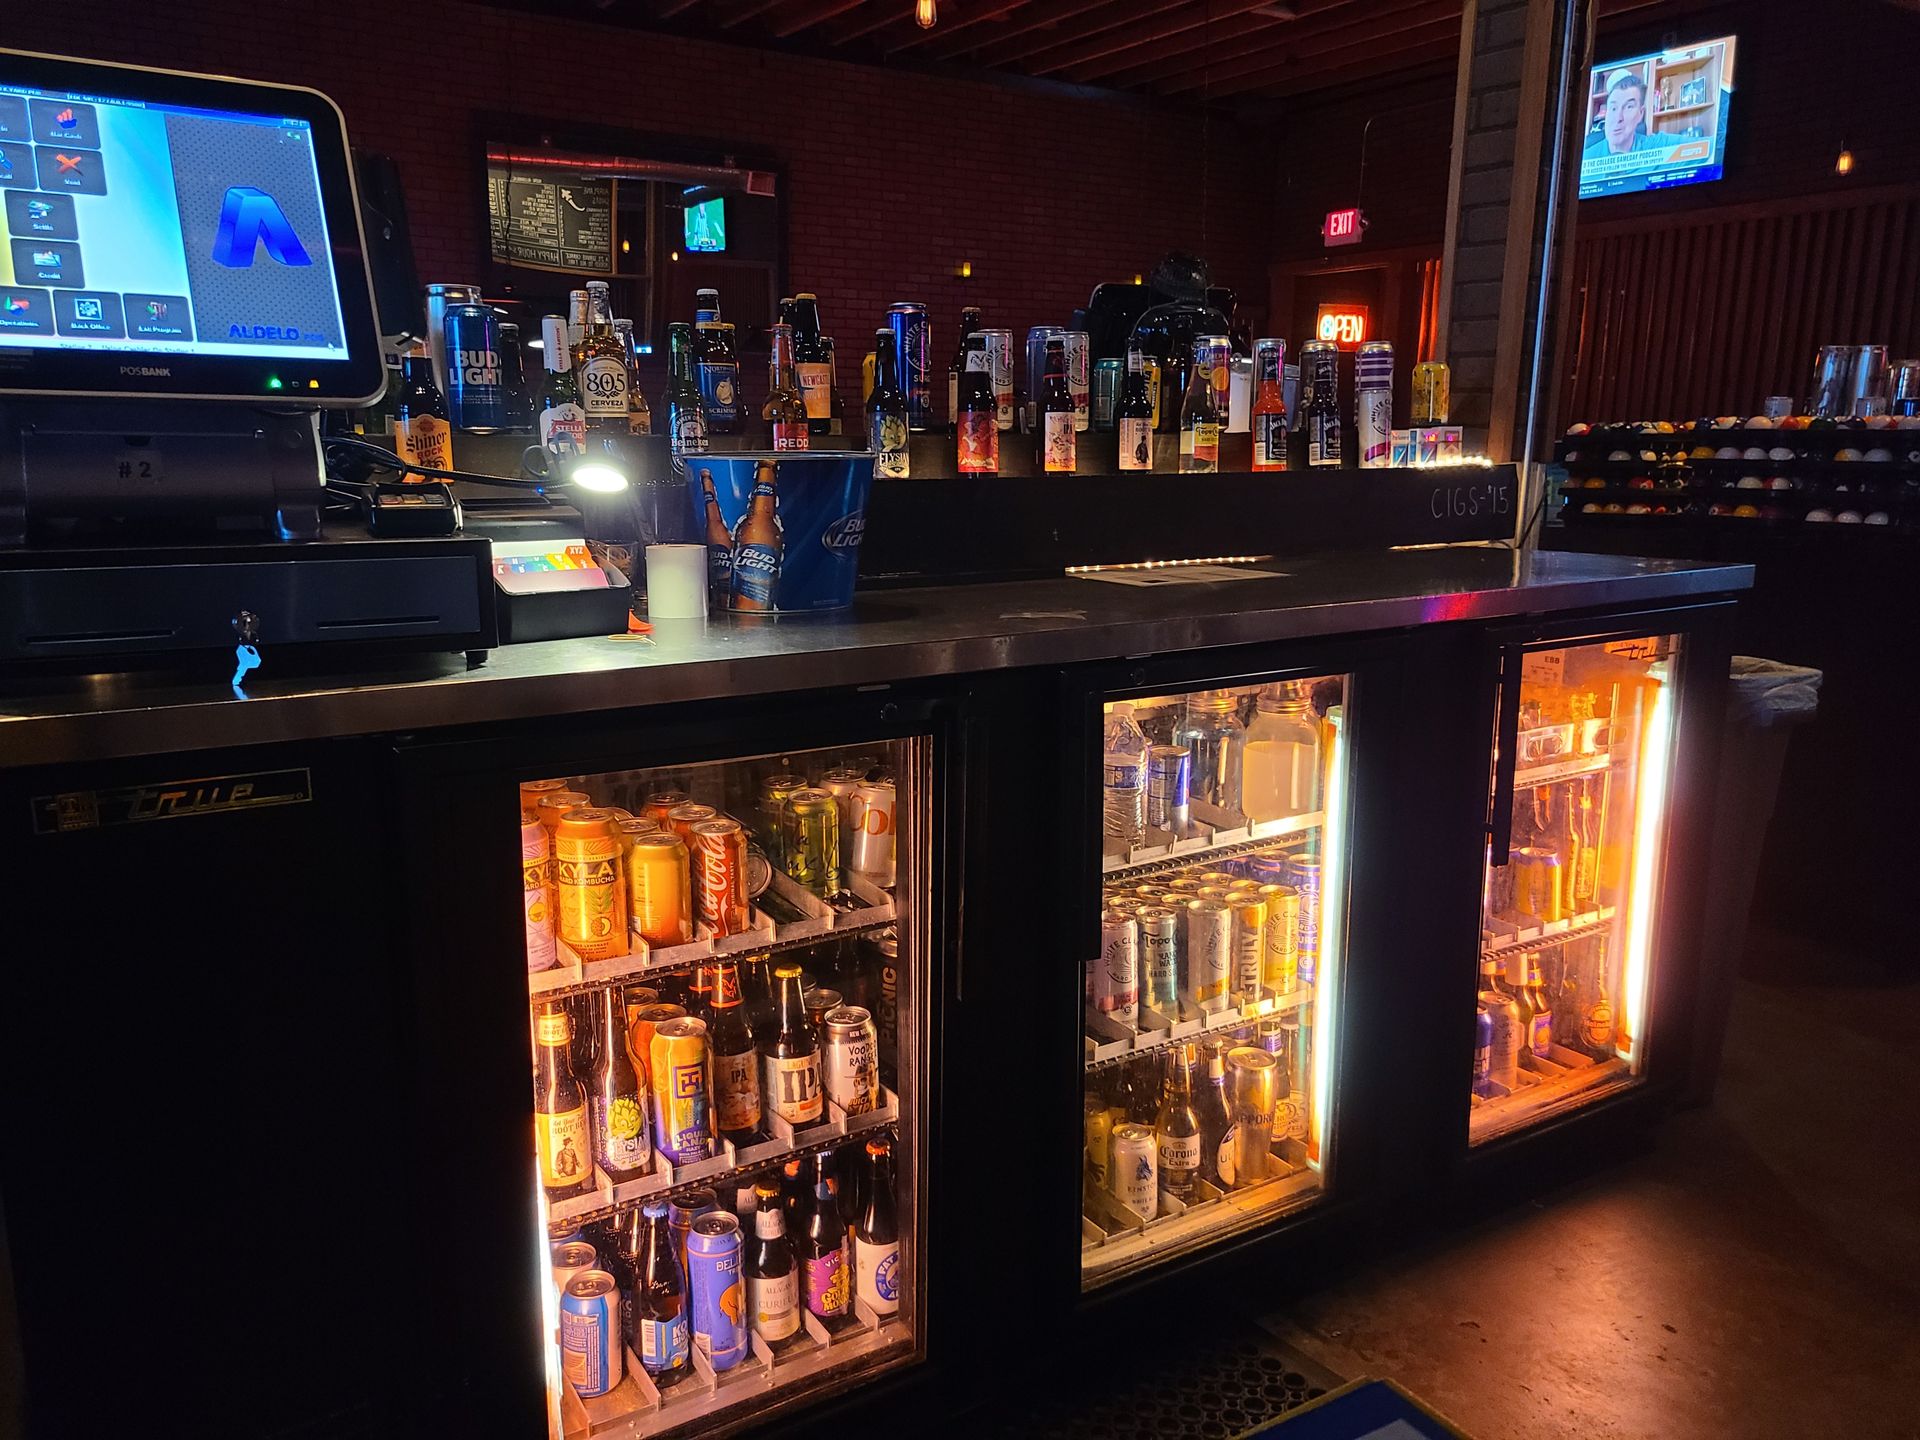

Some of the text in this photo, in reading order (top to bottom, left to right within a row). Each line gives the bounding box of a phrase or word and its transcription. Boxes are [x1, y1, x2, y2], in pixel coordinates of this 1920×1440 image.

[1330, 212, 1354, 236] EXIT
[230, 324, 300, 340] ALDELO
[1320, 314, 1363, 343] OPEN
[454, 350, 500, 368] BUD
[120, 366, 171, 377] POSBANK
[586, 373, 626, 393] 805
[1371, 400, 1384, 423] WHITE
[406, 430, 448, 452] Shiner
[417, 446, 444, 460] BOCK
[570, 547, 584, 555] XYZ
[742, 548, 776, 564] BUD
[734, 556, 778, 574] LIGHT
[559, 860, 614, 878] KYLA
[574, 875, 616, 885] KOMBUCHA
[1142, 932, 1171, 948] Topo
[1272, 942, 1288, 952] HARD
[1104, 940, 1121, 966] WHITE
[1240, 931, 1259, 989] TRULY
[1112, 972, 1129, 982] HARD
[731, 1068, 748, 1084] IPA
[552, 1124, 575, 1135] ROOT
[1160, 1146, 1198, 1159] Corona
[1168, 1158, 1190, 1166] Extra
[878, 1256, 894, 1275] FAT
